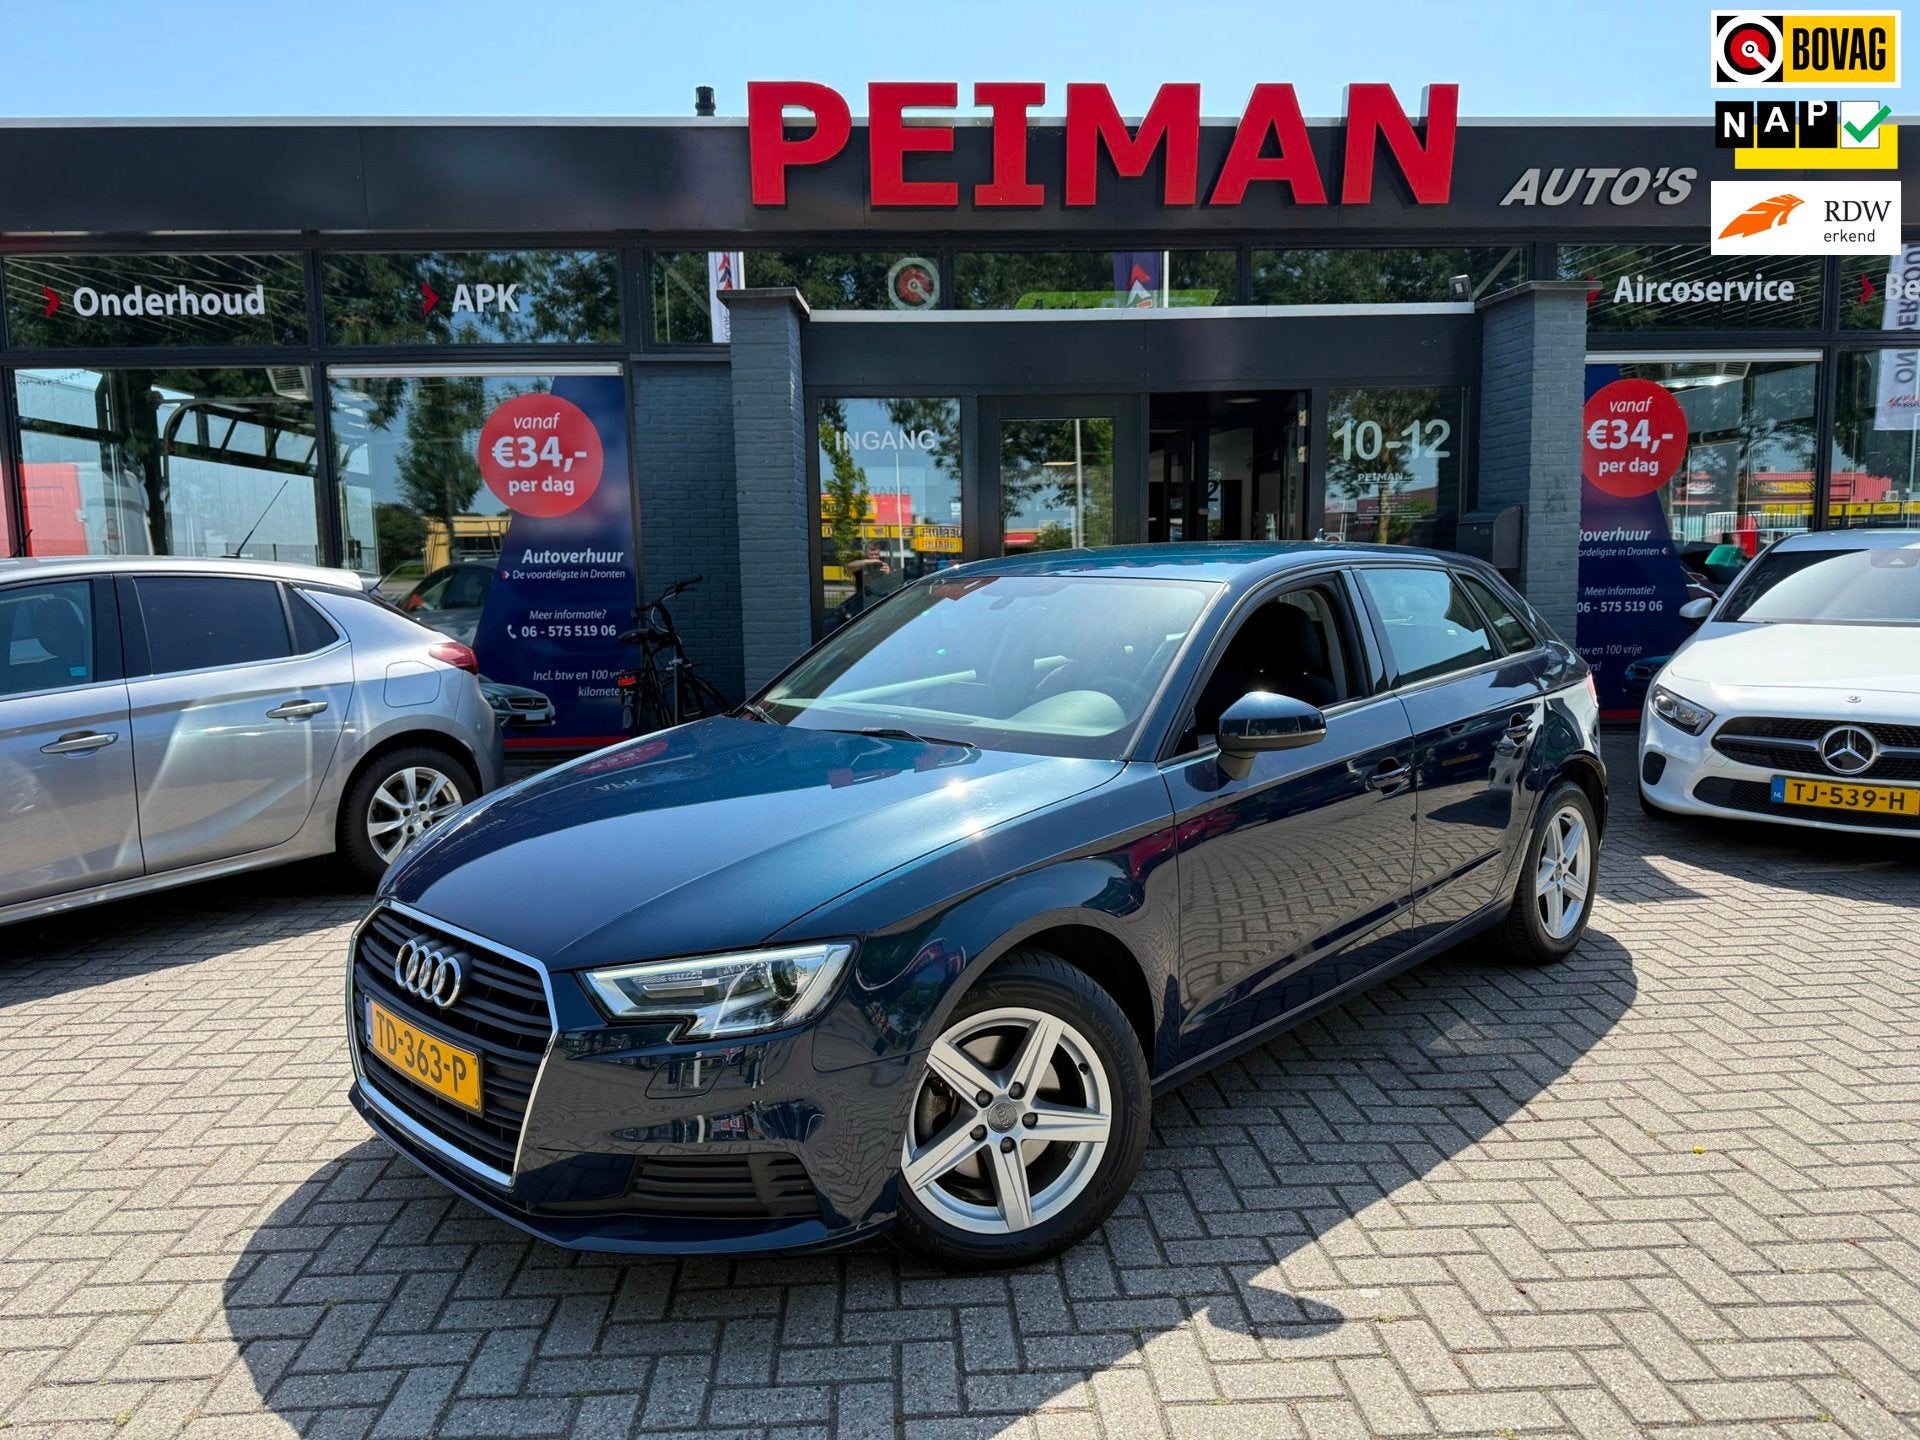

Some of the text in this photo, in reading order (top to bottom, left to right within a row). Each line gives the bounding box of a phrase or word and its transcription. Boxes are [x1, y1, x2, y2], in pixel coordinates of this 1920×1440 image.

[747, 81, 1460, 208] PEIMAN
[1500, 167, 1698, 208] AUTO'S
[1613, 273, 1795, 304] Aircoservice
[72, 284, 265, 316] Onderhoud
[452, 283, 520, 313] APK
[1609, 396, 1654, 412] vanaf
[513, 412, 561, 429] vanaf
[835, 429, 936, 451] INGANG
[1332, 419, 1451, 460] 10-12
[1586, 419, 1674, 454] €34,-
[492, 436, 588, 472] €34,-
[1598, 457, 1659, 477] per dag
[508, 476, 575, 496] per dag
[1357, 472, 1404, 482] PEIMAN
[1579, 527, 1651, 542] toverhuur
[521, 548, 624, 564] Autoverhuur
[1578, 547, 1660, 558] ordeligste in Dronten
[512, 569, 626, 581] De voordeligste in Dronten
[1584, 585, 1656, 596] Meer informatie?
[529, 609, 607, 620] Meer informatie?
[1576, 602, 1591, 613] 06
[1600, 601, 1622, 612] 575
[1624, 601, 1646, 612] 519
[1648, 600, 1663, 611] 06
[521, 626, 538, 637] 06
[548, 625, 572, 637] 575
[574, 625, 598, 637] 519
[600, 625, 617, 636] 06
[1592, 647, 1603, 655] en
[1605, 645, 1622, 655] 100
[1623, 645, 1643, 656] vrije
[533, 670, 553, 681] Incl.
[555, 670, 575, 680] btw
[576, 672, 588, 680] en
[591, 670, 609, 680] 100
[1793, 783, 1905, 811] TJ-539-H
[375, 1010, 467, 1093] TD-363-P
